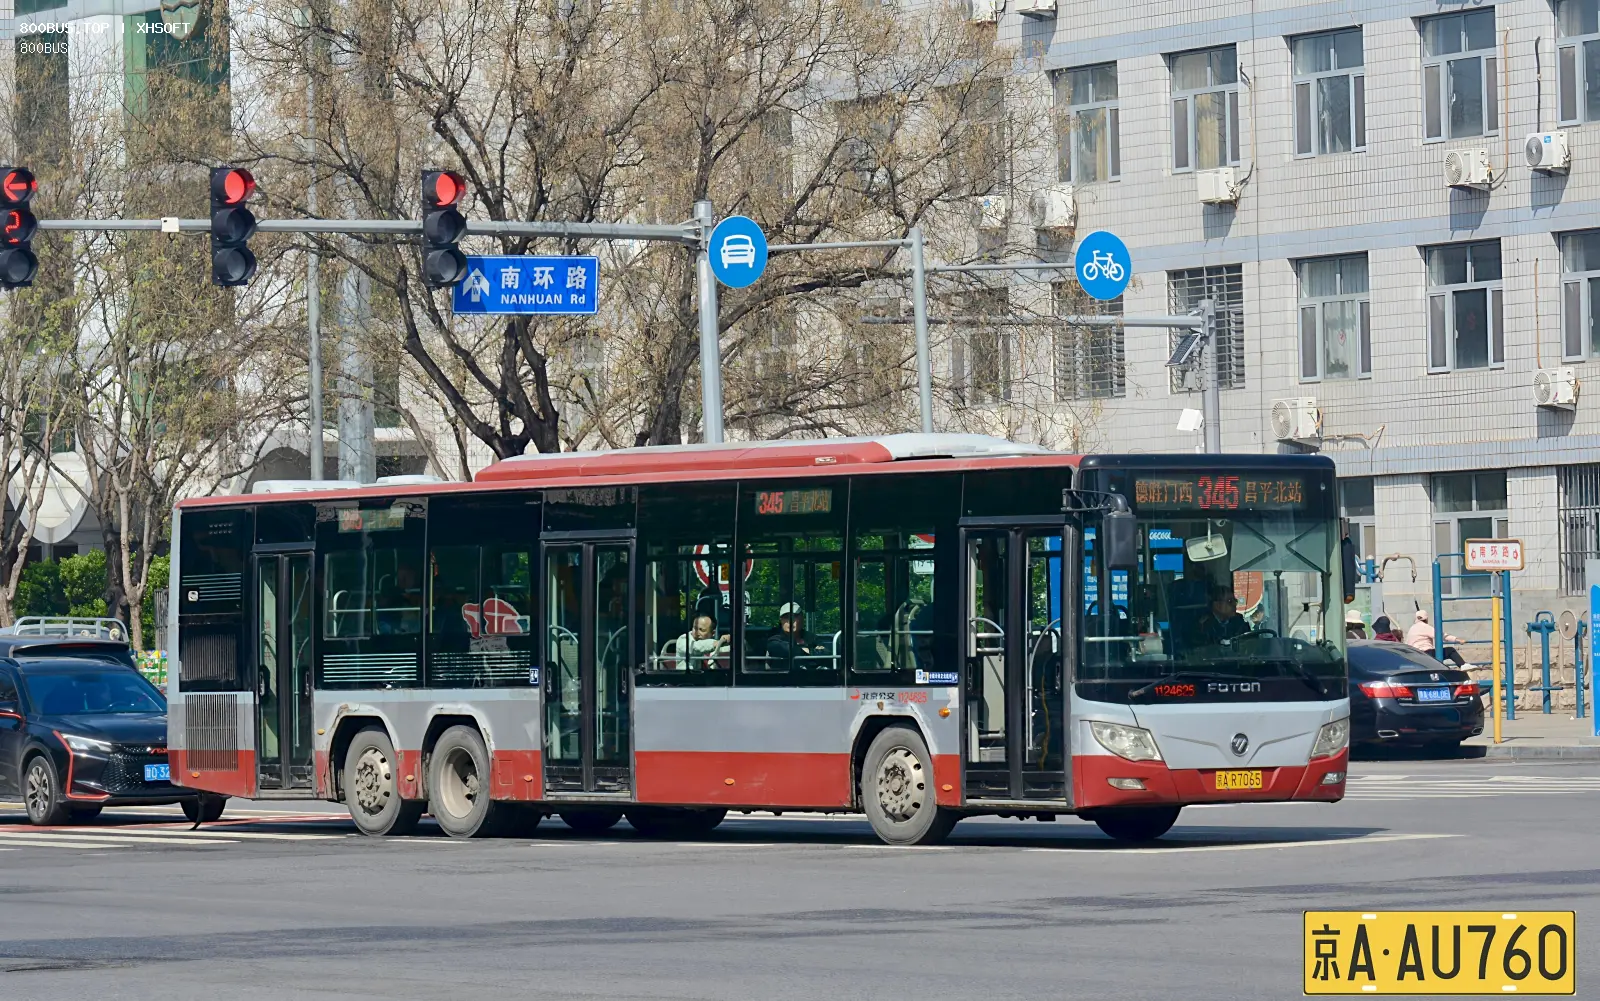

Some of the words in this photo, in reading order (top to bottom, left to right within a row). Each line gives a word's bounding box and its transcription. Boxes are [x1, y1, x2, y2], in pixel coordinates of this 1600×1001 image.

[500, 266, 588, 290] 南环路
[501, 294, 563, 305] NANHUAN
[570, 294, 586, 305] Rd
[1135, 481, 1193, 504] 德胜门西
[1198, 476, 1241, 509] 345
[1245, 481, 1302, 503] 昌平北站
[758, 491, 784, 514] 345
[862, 691, 896, 701] 北京公交
[897, 691, 929, 704] 1124625
[1154, 684, 1195, 697] 1124625
[1207, 682, 1261, 693] FOTON
